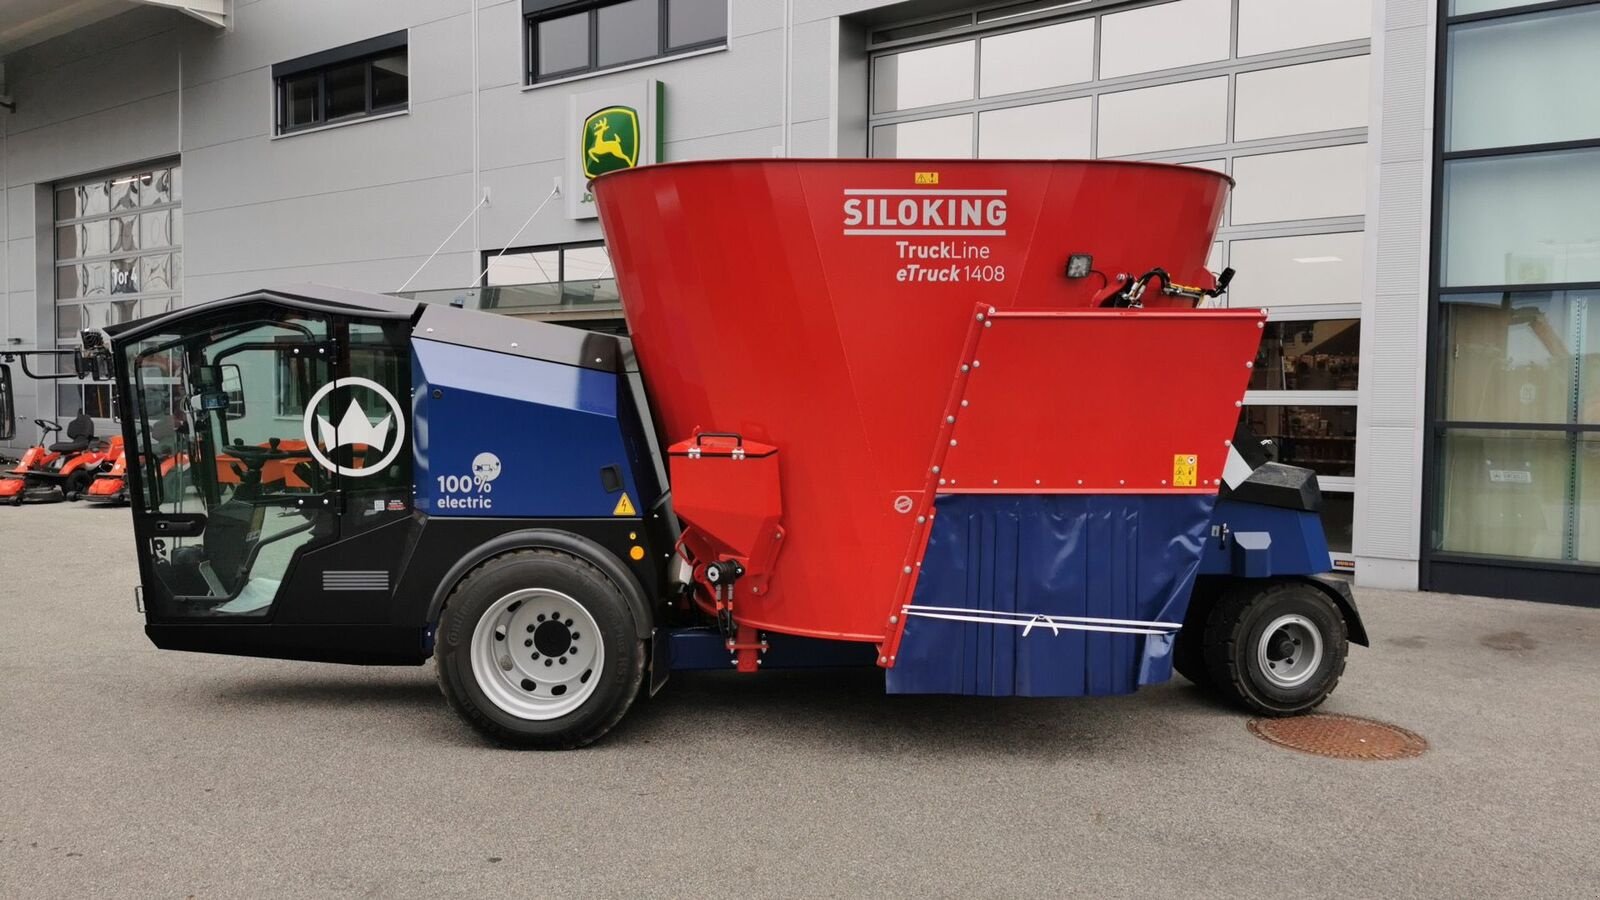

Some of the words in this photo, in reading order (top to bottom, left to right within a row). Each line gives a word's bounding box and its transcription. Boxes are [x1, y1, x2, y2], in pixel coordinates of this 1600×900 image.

[843, 198, 1007, 226] SILOKING
[896, 241, 990, 259] TruckLine
[112, 268, 128, 286] Tor
[130, 267, 138, 283] 4
[896, 264, 960, 282] eTruck
[964, 265, 1005, 282] 1408
[437, 475, 491, 493] 100%
[437, 495, 492, 508] electric
